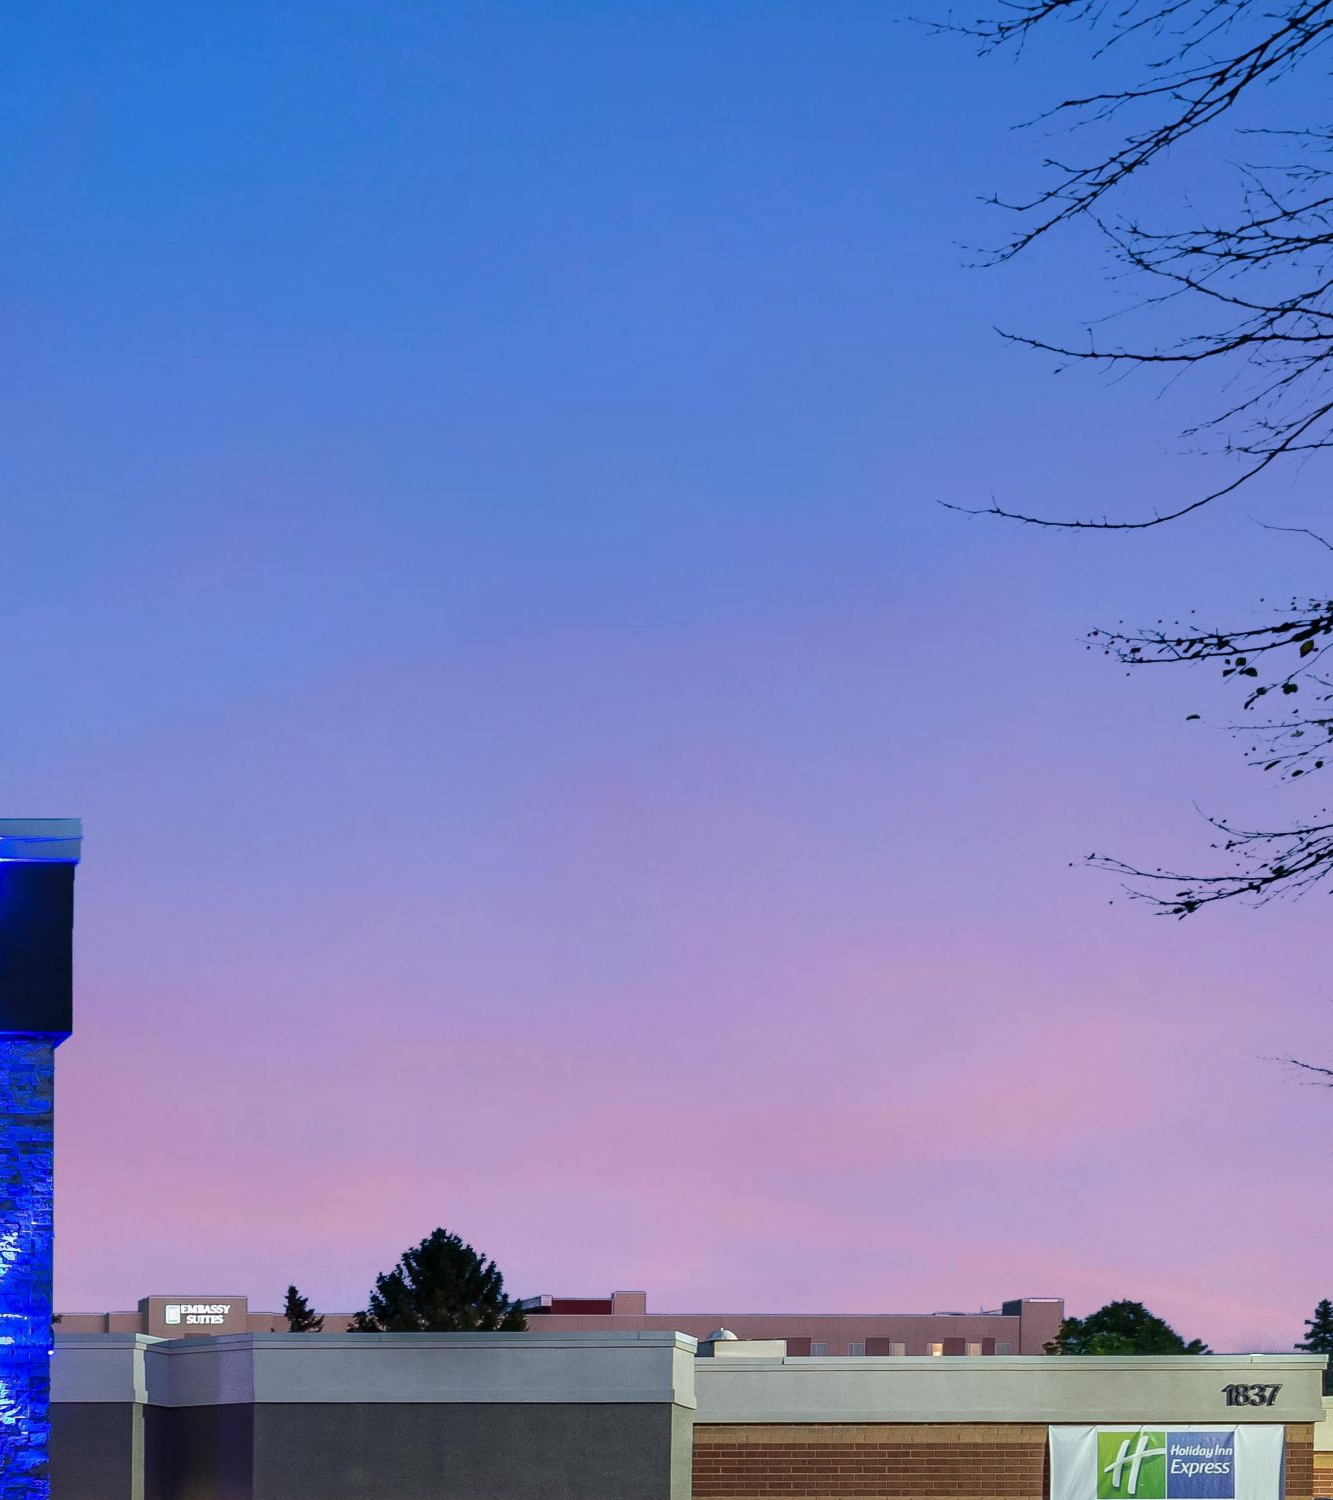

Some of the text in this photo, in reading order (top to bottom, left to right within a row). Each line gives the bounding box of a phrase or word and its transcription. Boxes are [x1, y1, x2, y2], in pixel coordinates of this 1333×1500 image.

[180, 1304, 231, 1314] EMBASSY
[186, 1314, 224, 1324] SUITES
[1221, 1383, 1283, 1407] 1837
[1170, 1444, 1233, 1459] Holiday Inn
[1170, 1459, 1231, 1477] Express
